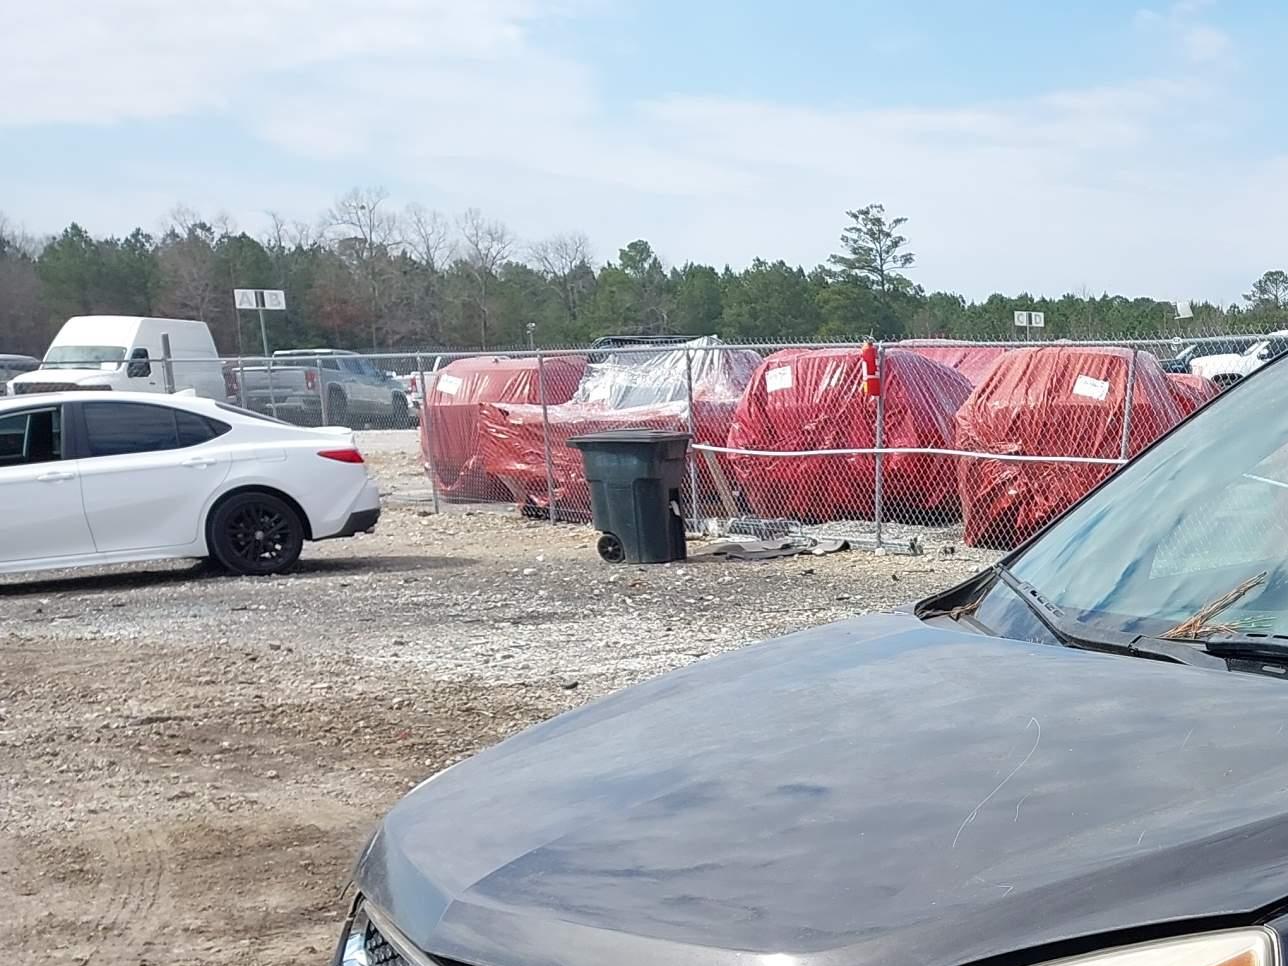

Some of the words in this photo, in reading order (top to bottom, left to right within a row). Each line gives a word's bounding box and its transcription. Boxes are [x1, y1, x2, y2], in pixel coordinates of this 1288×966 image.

[239, 291, 253, 306] A
[269, 292, 281, 307] B
[1016, 312, 1025, 325] C
[1033, 313, 1042, 325] D
